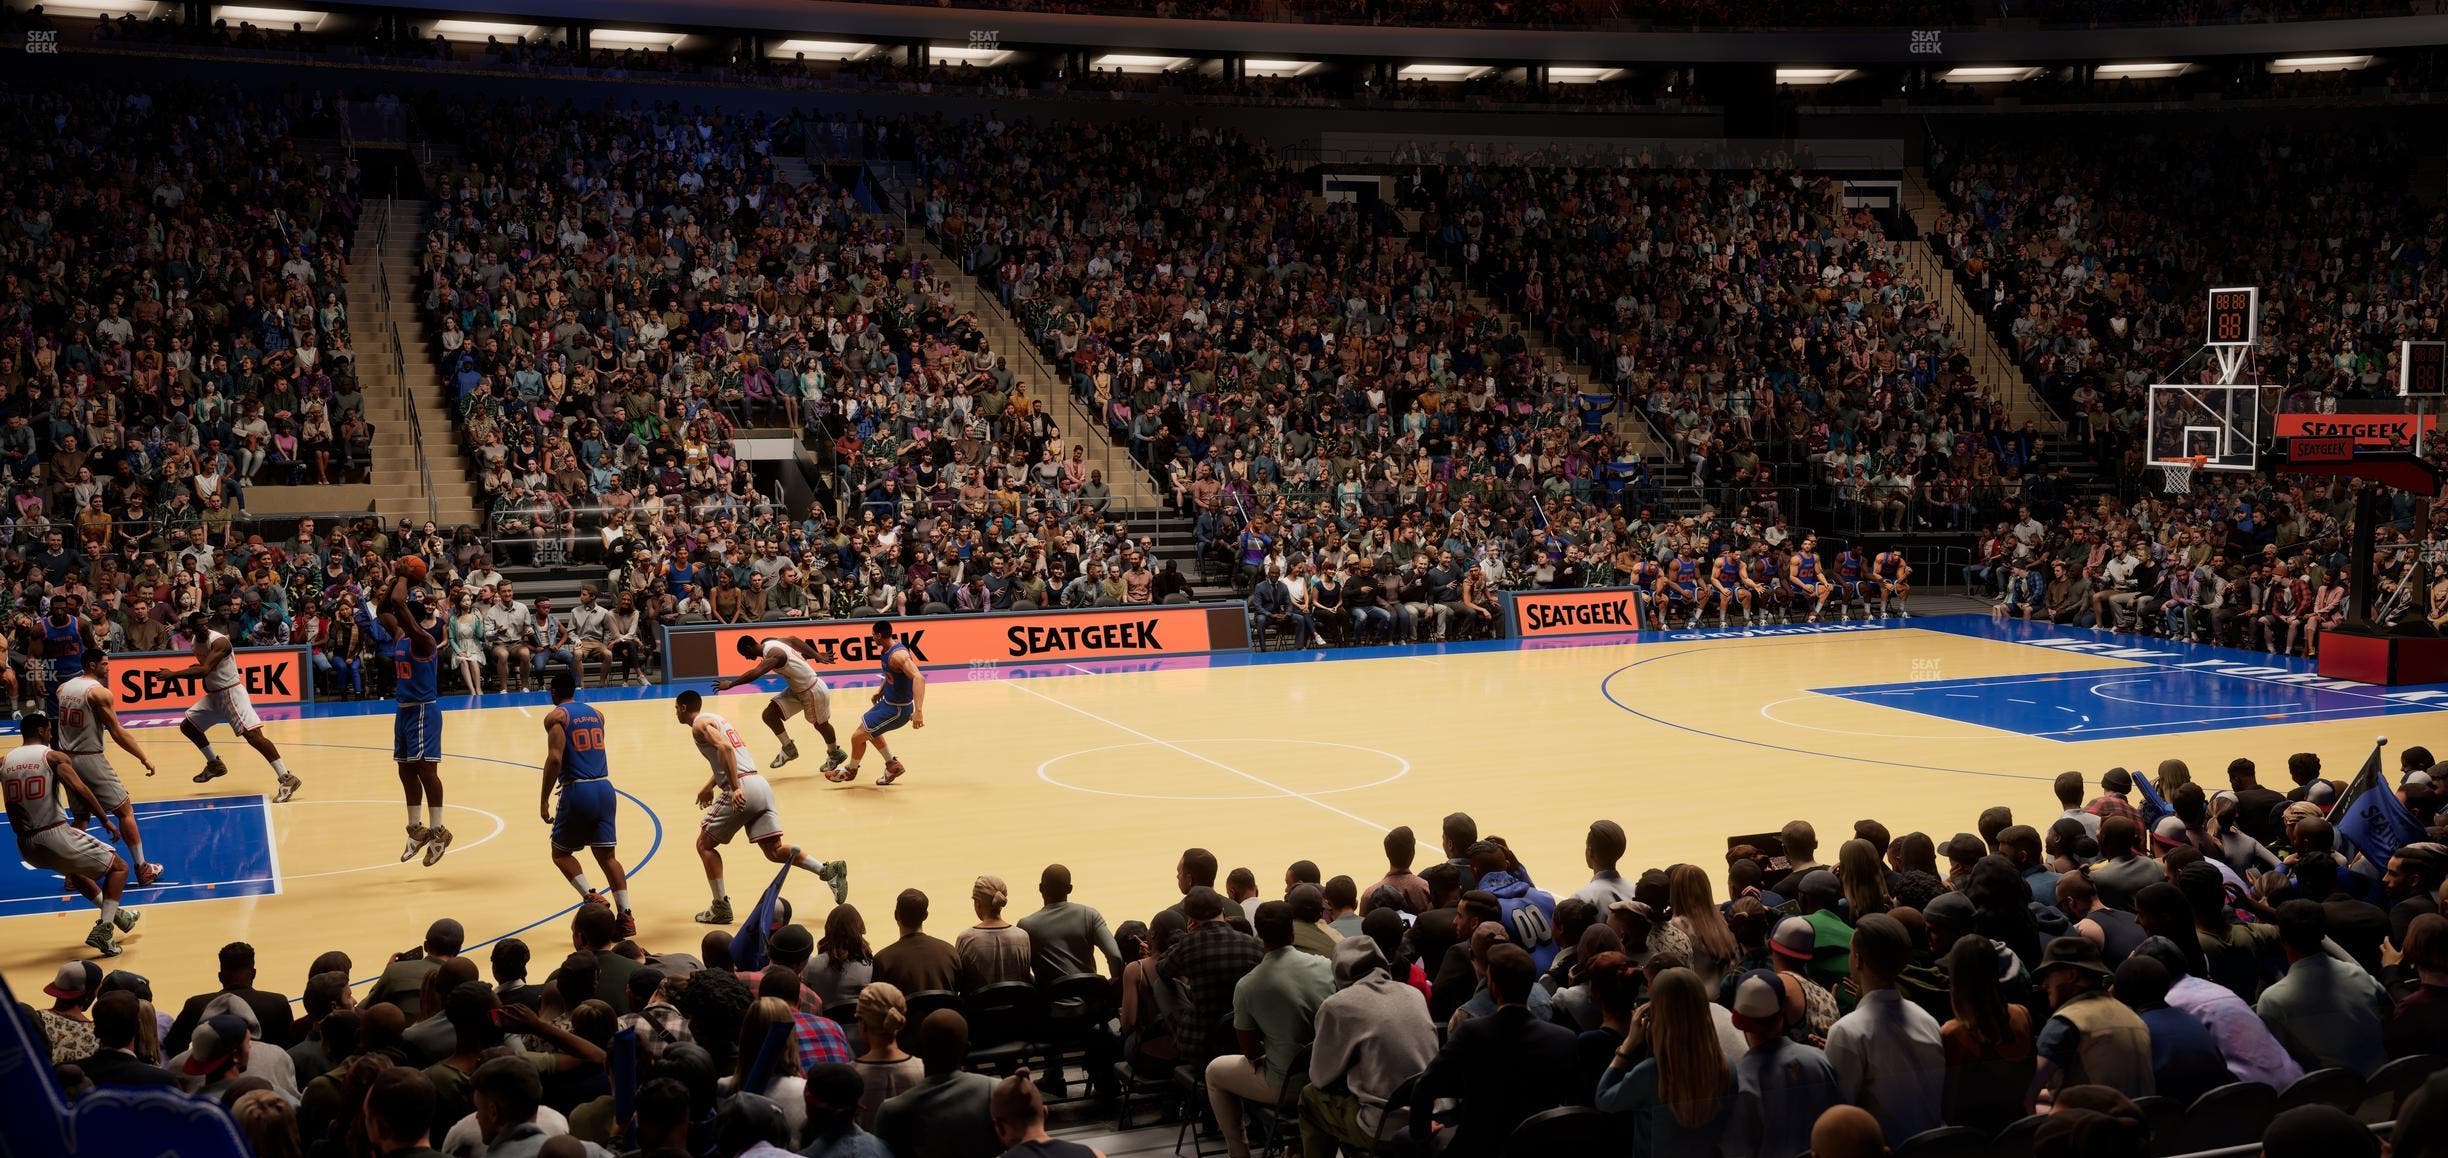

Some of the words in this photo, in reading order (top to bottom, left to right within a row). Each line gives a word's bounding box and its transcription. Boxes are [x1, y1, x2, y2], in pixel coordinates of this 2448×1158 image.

[2218, 313, 2241, 339] 88
[2302, 422, 2408, 440] SEATGEEK
[2297, 442, 2346, 457] SEATGEEK
[1526, 599, 1632, 630] SEATGEEK
[1007, 619, 1163, 657] SEATGEEK
[1670, 624, 1886, 640] @nyknicks
[2016, 637, 2184, 658] NEW
[2172, 658, 2378, 690] YORK
[572, 727, 605, 752] 00
[6, 775, 46, 802] 00
[1512, 903, 1552, 953] 00
